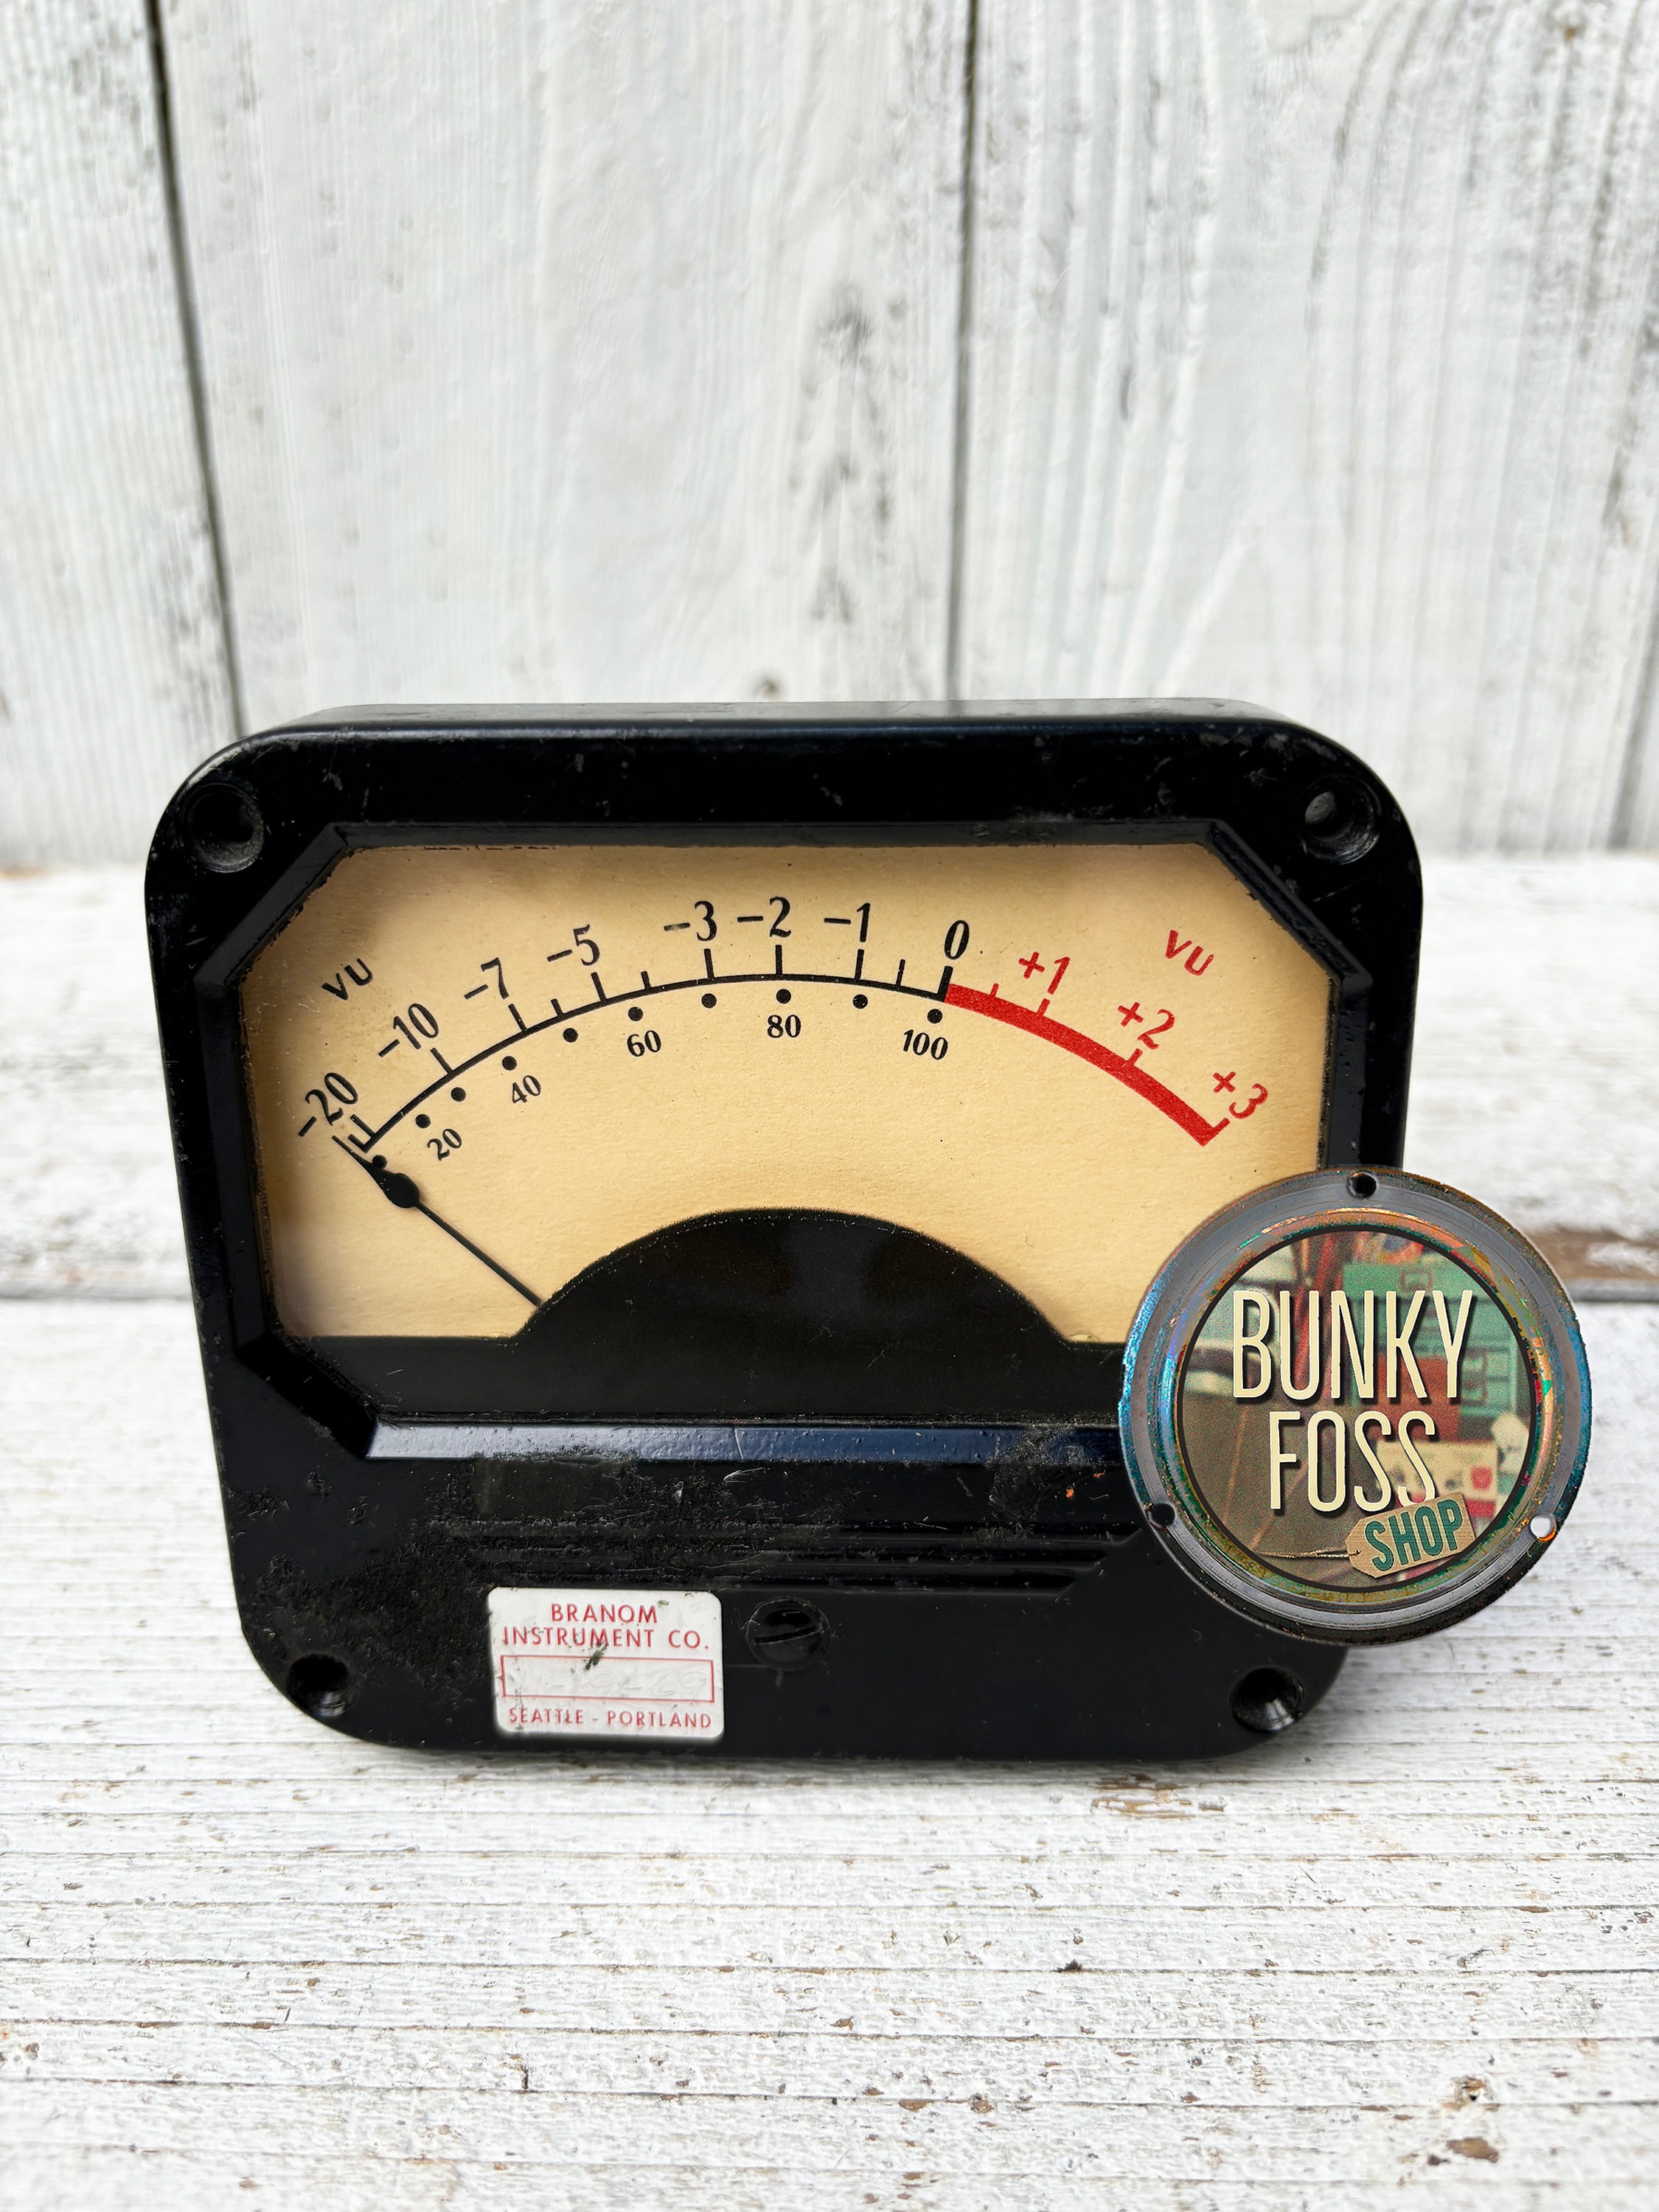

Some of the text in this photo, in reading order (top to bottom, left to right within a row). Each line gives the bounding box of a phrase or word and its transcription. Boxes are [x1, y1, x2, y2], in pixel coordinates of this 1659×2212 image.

[664, 901, 717, 941] -3
[737, 897, 791, 937] -2
[824, 903, 870, 942] -1
[547, 925, 599, 966] -5
[945, 920, 970, 959] 0
[1166, 930, 1214, 975] VU
[321, 959, 372, 1000] VU
[465, 957, 509, 999] -7
[1019, 952, 1070, 995] +1
[378, 1004, 439, 1057] -10
[627, 1031, 661, 1057] 60
[768, 1015, 801, 1038] 80
[903, 1029, 947, 1060] 100
[1118, 1002, 1175, 1049] +2
[299, 1073, 358, 1137] -20
[512, 1075, 540, 1103] 40
[1213, 1071, 1268, 1119] +3
[427, 1129, 462, 1161] 20
[552, 1604, 657, 1623] BRANOM
[504, 1627, 708, 1649] INSTRUMENT CO.
[509, 1708, 582, 1724] SEATTLE
[608, 1711, 711, 1728] PORTLAND
